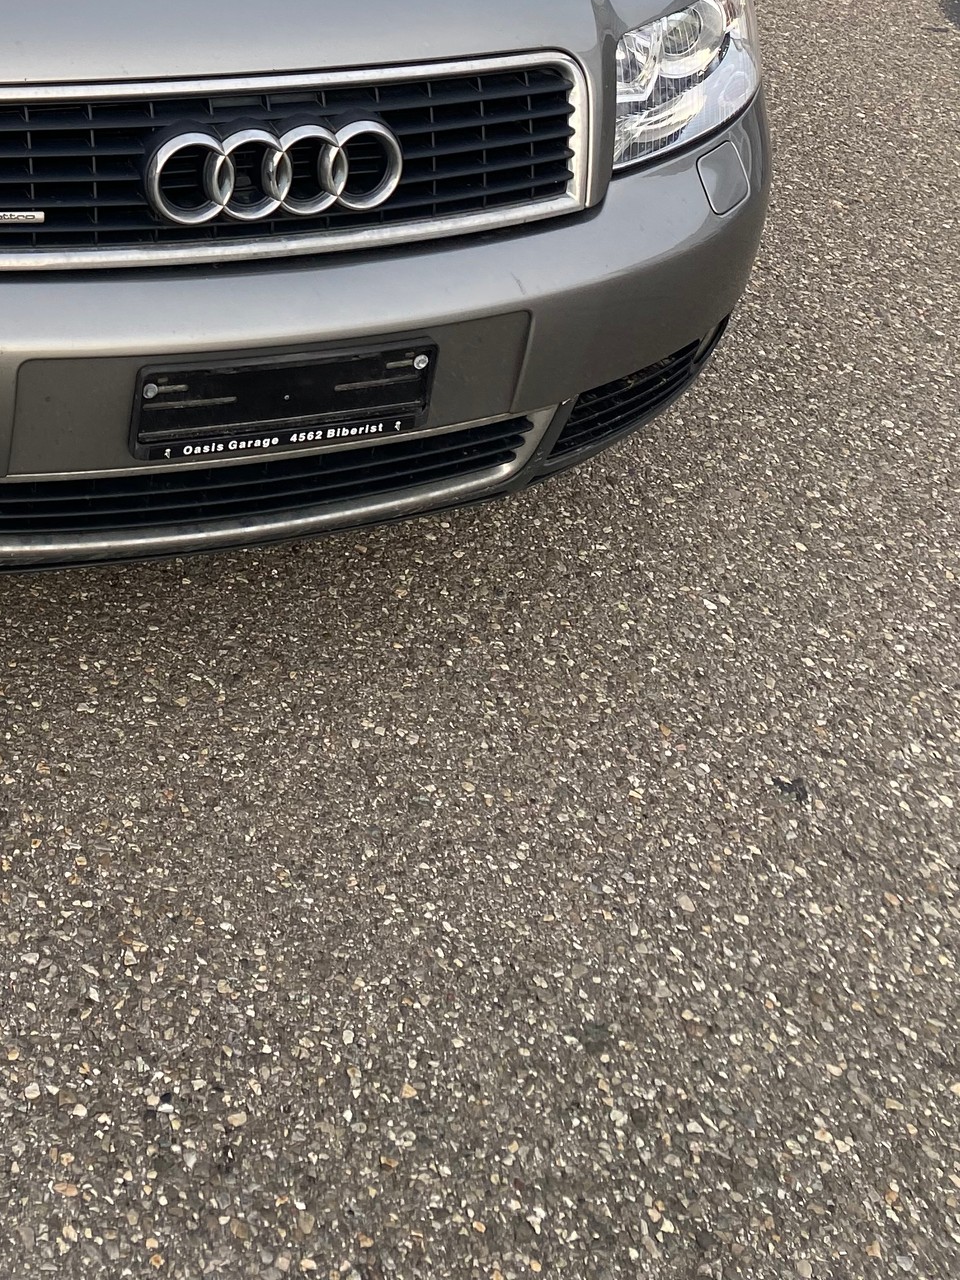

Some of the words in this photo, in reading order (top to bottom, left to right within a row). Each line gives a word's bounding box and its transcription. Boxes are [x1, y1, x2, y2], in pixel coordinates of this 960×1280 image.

[182, 442, 224, 456] Oasis
[228, 436, 280, 450] Garage
[289, 430, 323, 443] 4562
[326, 422, 384, 439] Biberist
